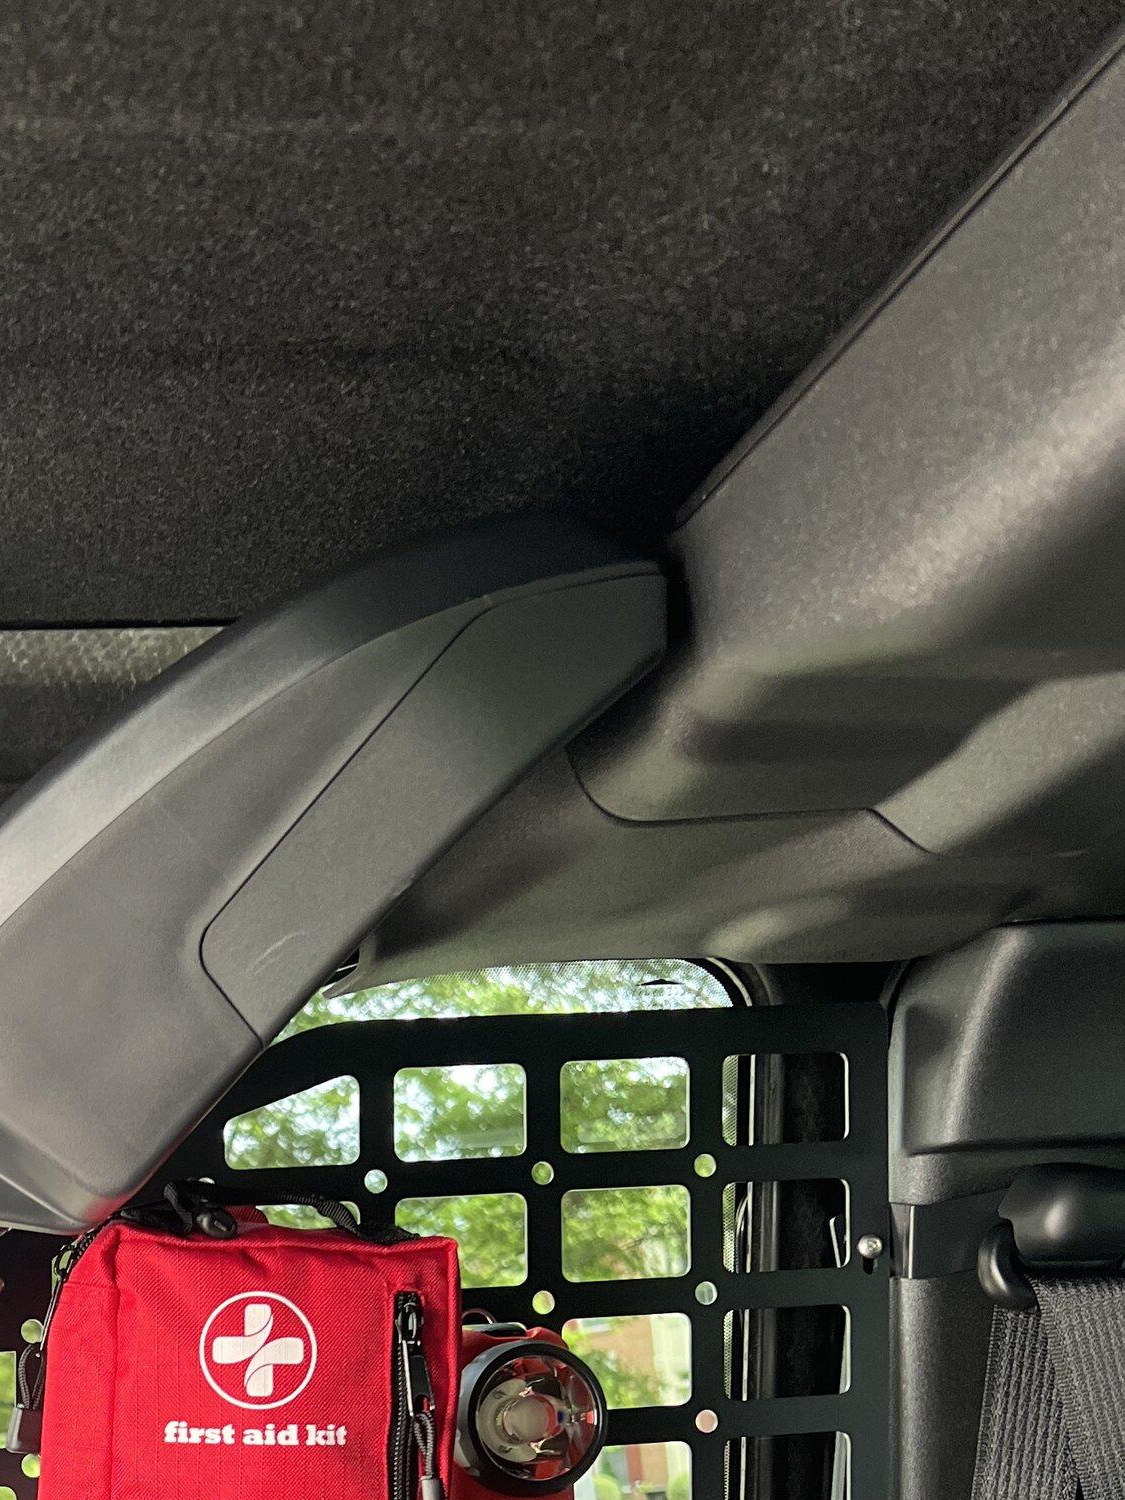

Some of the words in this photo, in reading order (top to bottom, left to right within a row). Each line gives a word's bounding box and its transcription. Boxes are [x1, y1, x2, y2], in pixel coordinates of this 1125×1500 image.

[164, 1421, 235, 1444] first
[243, 1424, 299, 1445] aid
[305, 1424, 347, 1446] kit
